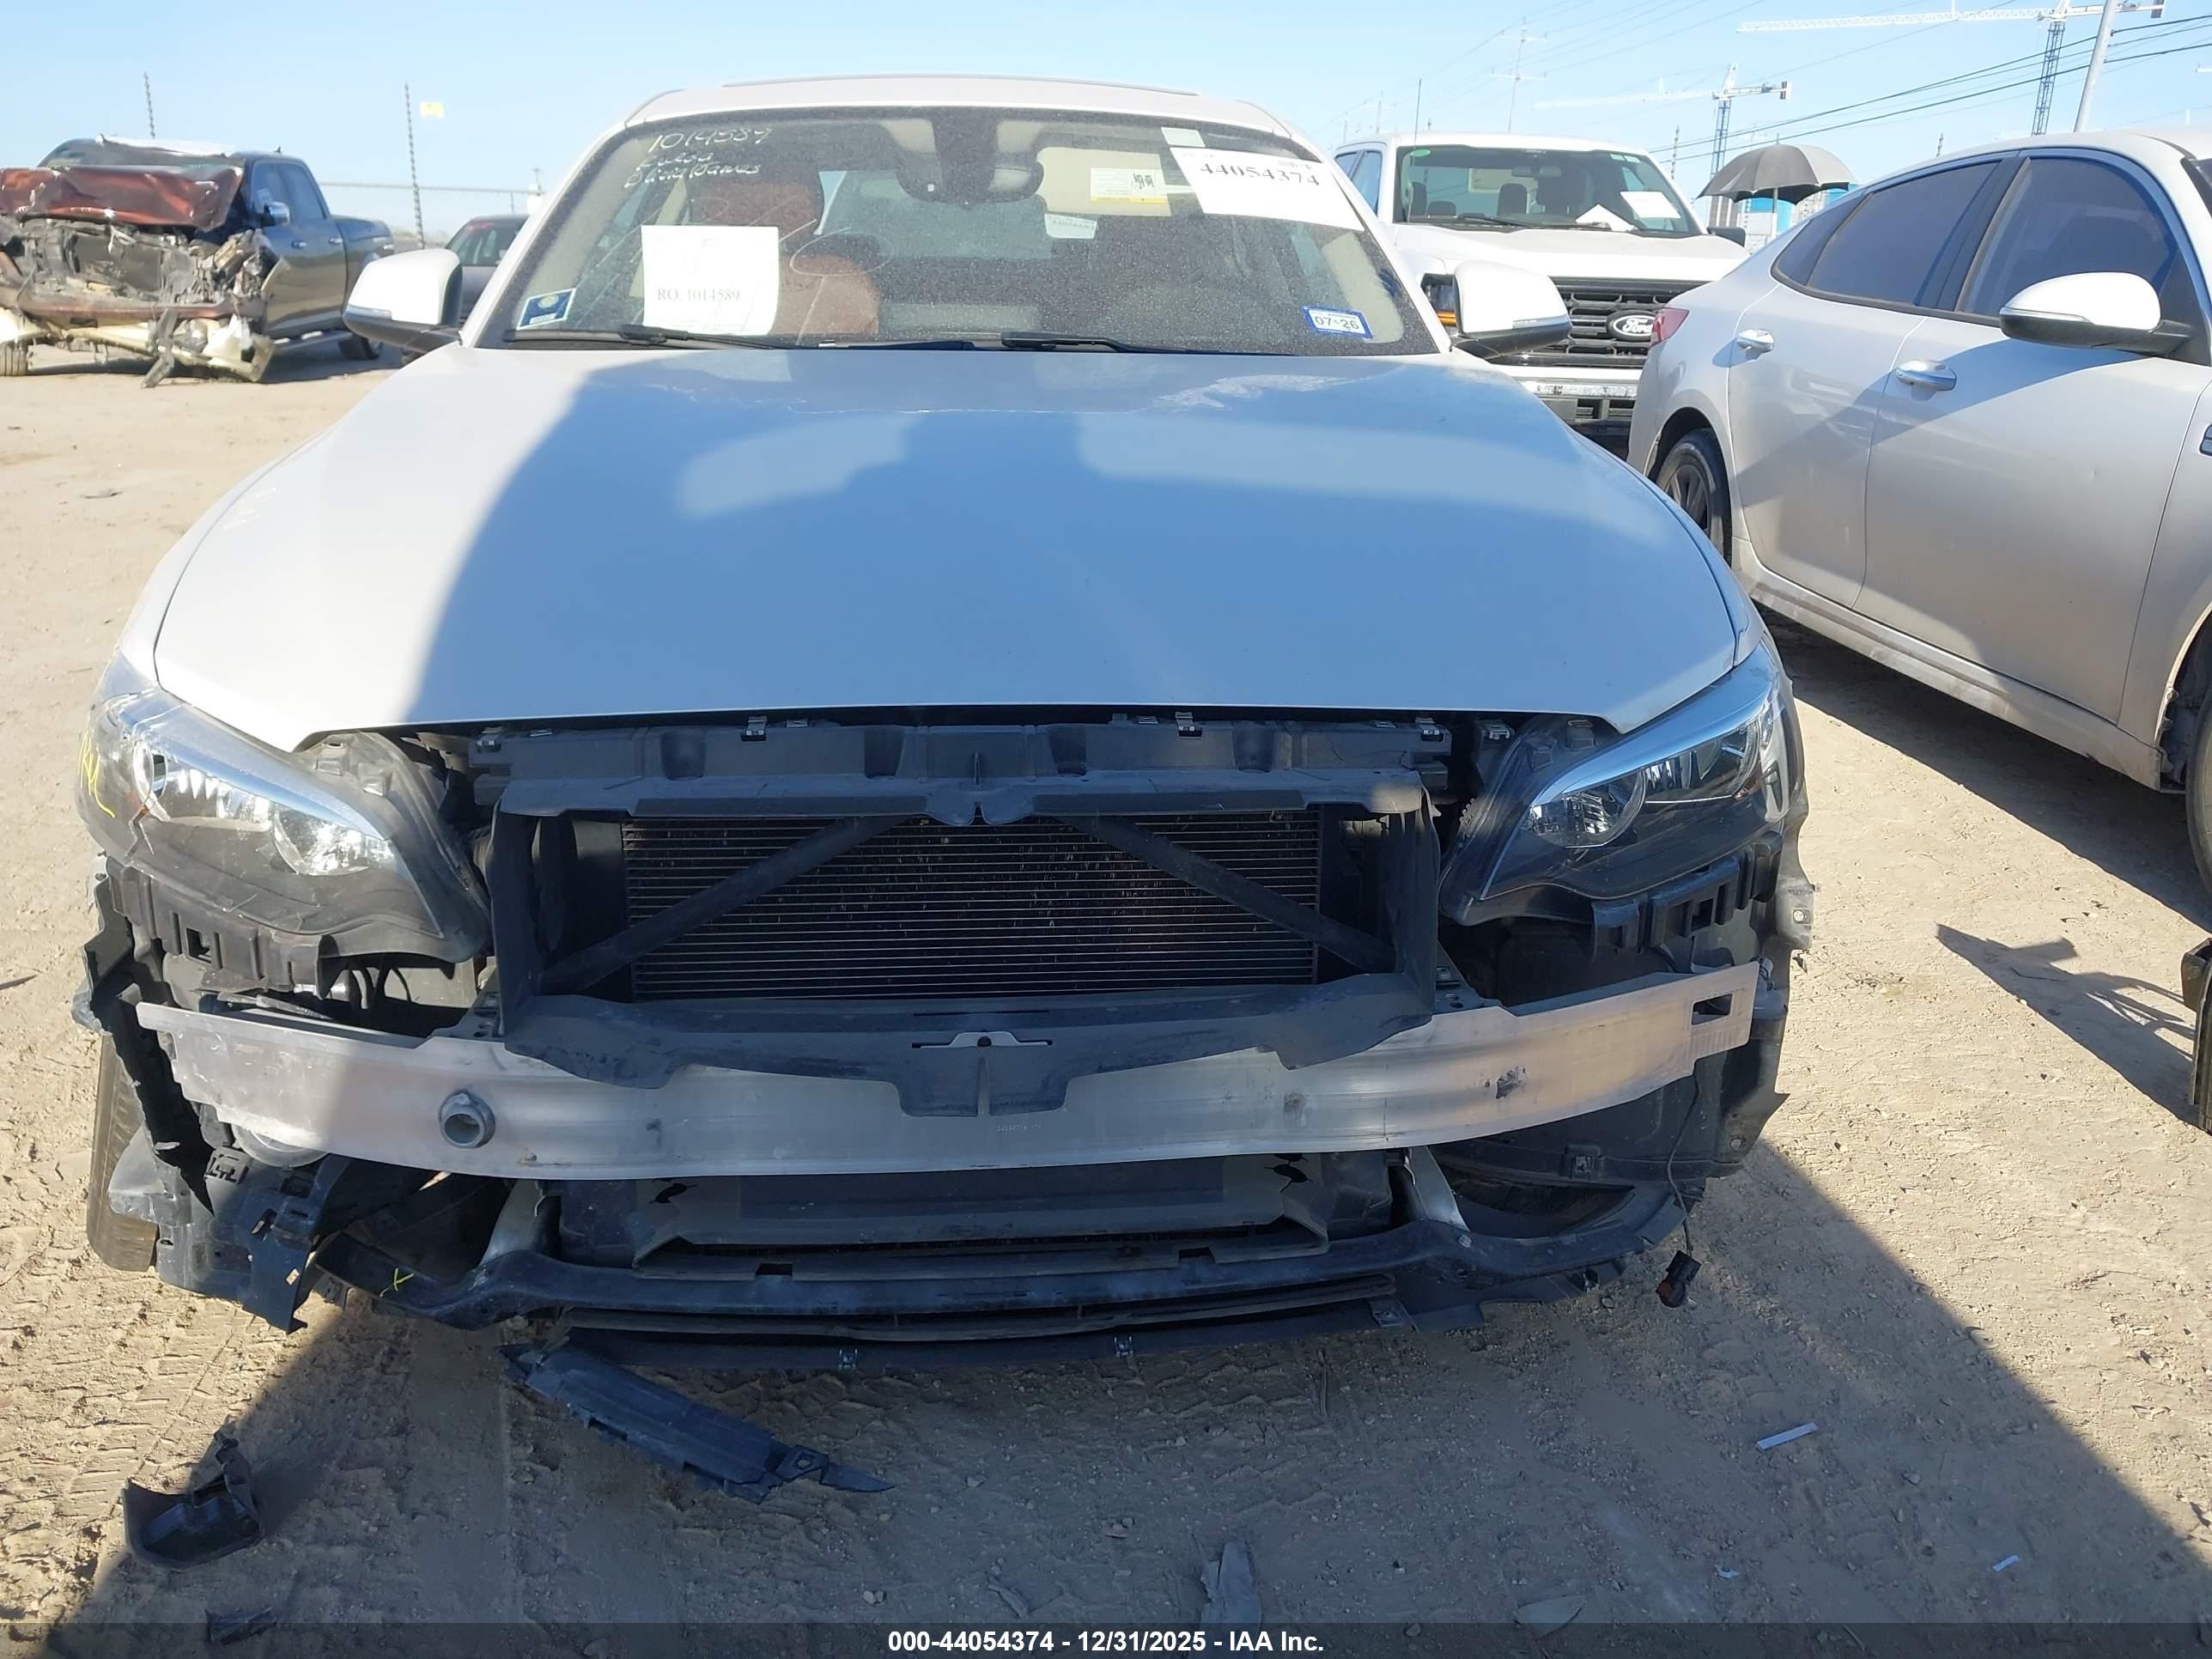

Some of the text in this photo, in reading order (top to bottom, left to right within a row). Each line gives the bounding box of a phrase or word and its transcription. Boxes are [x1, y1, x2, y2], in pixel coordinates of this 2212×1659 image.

[1200, 162, 1320, 186] 44054374
[657, 288, 741, 302] RO: 1014589
